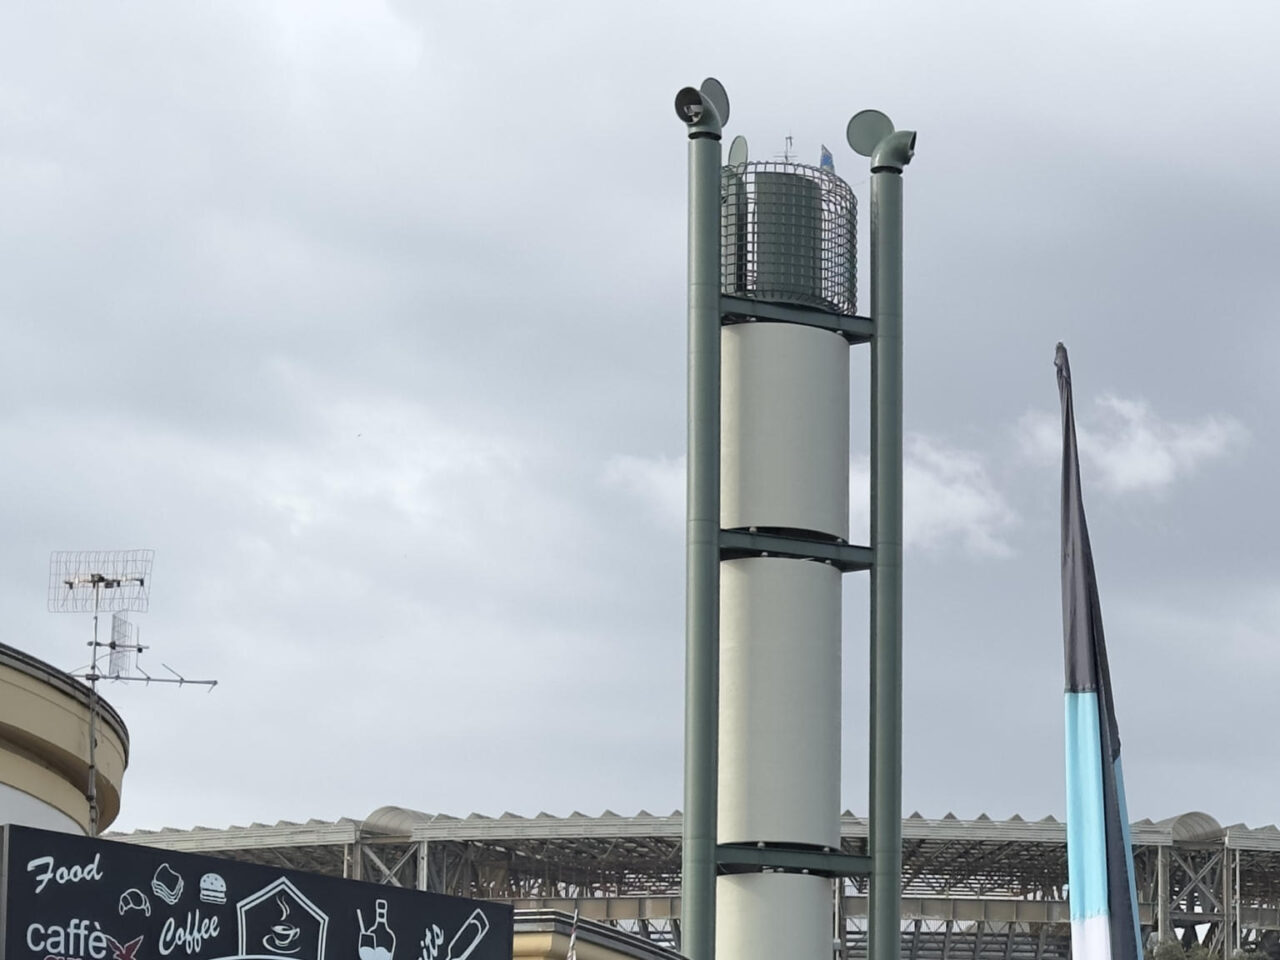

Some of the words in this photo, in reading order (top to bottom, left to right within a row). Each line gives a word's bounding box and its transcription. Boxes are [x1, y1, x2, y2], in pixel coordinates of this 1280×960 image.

[27, 853, 103, 894] Food
[26, 918, 107, 959] caffè
[158, 908, 220, 955] Coffee
